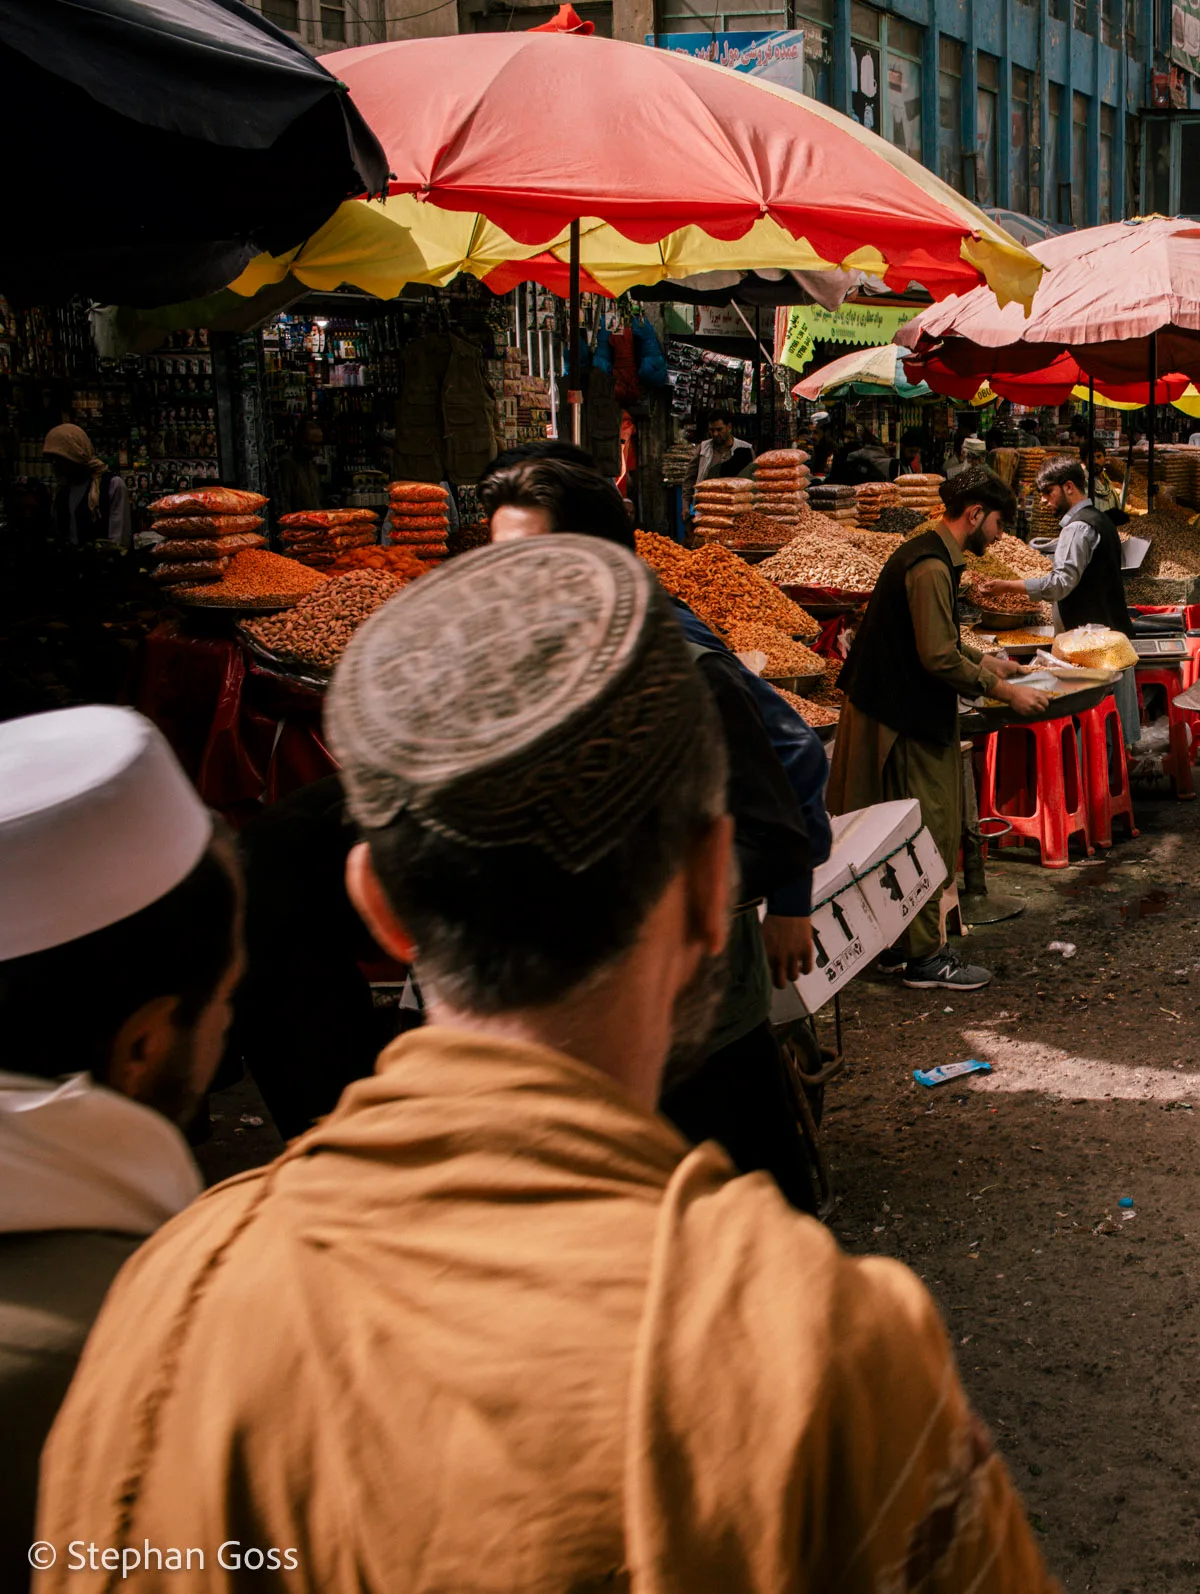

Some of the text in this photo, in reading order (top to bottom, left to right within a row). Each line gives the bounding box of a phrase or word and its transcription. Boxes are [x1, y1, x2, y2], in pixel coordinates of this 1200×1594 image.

[740, 38, 773, 67] فروشی
[774, 43, 799, 60] عمده
[937, 965, 959, 980] N
